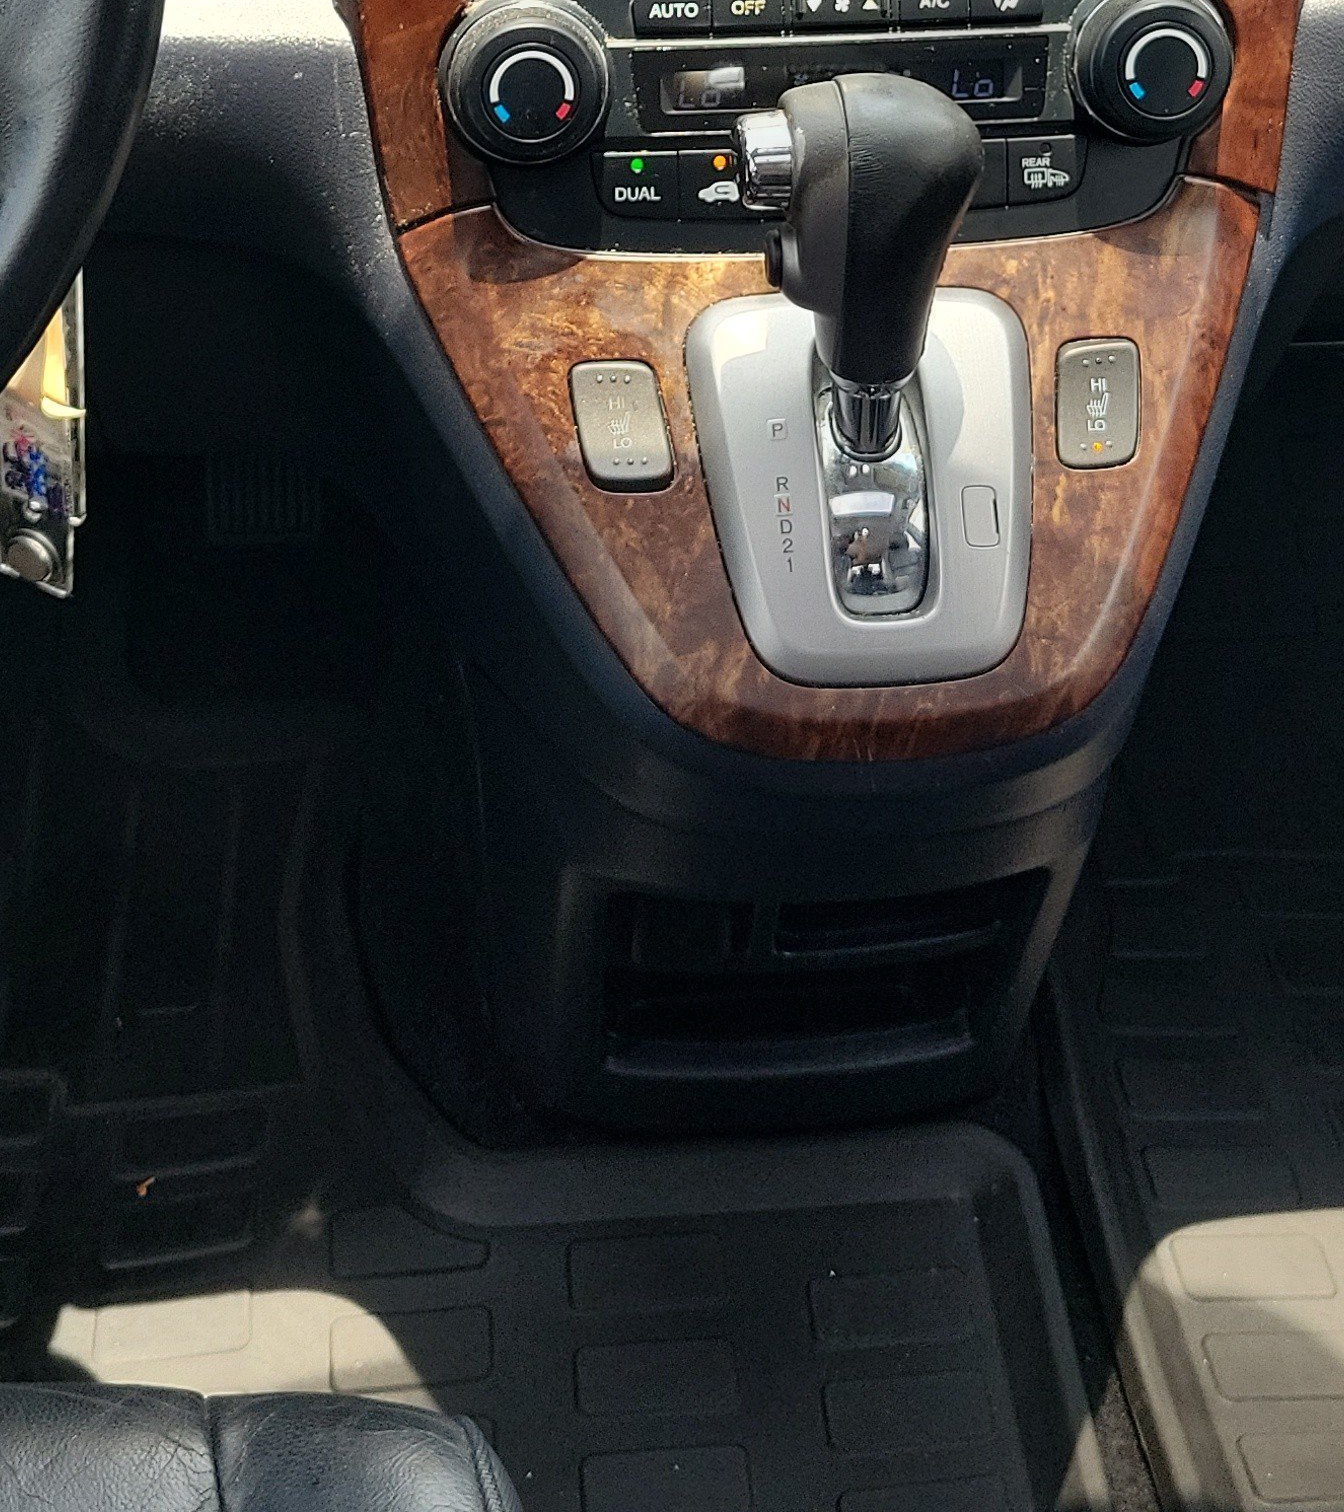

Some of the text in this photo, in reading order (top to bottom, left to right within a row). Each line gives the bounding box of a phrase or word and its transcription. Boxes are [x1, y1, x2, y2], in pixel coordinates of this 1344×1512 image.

[649, 2, 700, 19] AUTO
[730, 0, 767, 16] OFF
[1021, 157, 1051, 168] REAR
[614, 185, 662, 202] DUAL
[1090, 376, 1108, 393] HI
[608, 396, 626, 410] HI
[771, 423, 784, 437] P
[613, 437, 633, 449] LO
[776, 476, 789, 490] R
[778, 496, 791, 511] N
[781, 519, 793, 534] D
[782, 539, 794, 553] 2
[786, 557, 794, 573] 1
